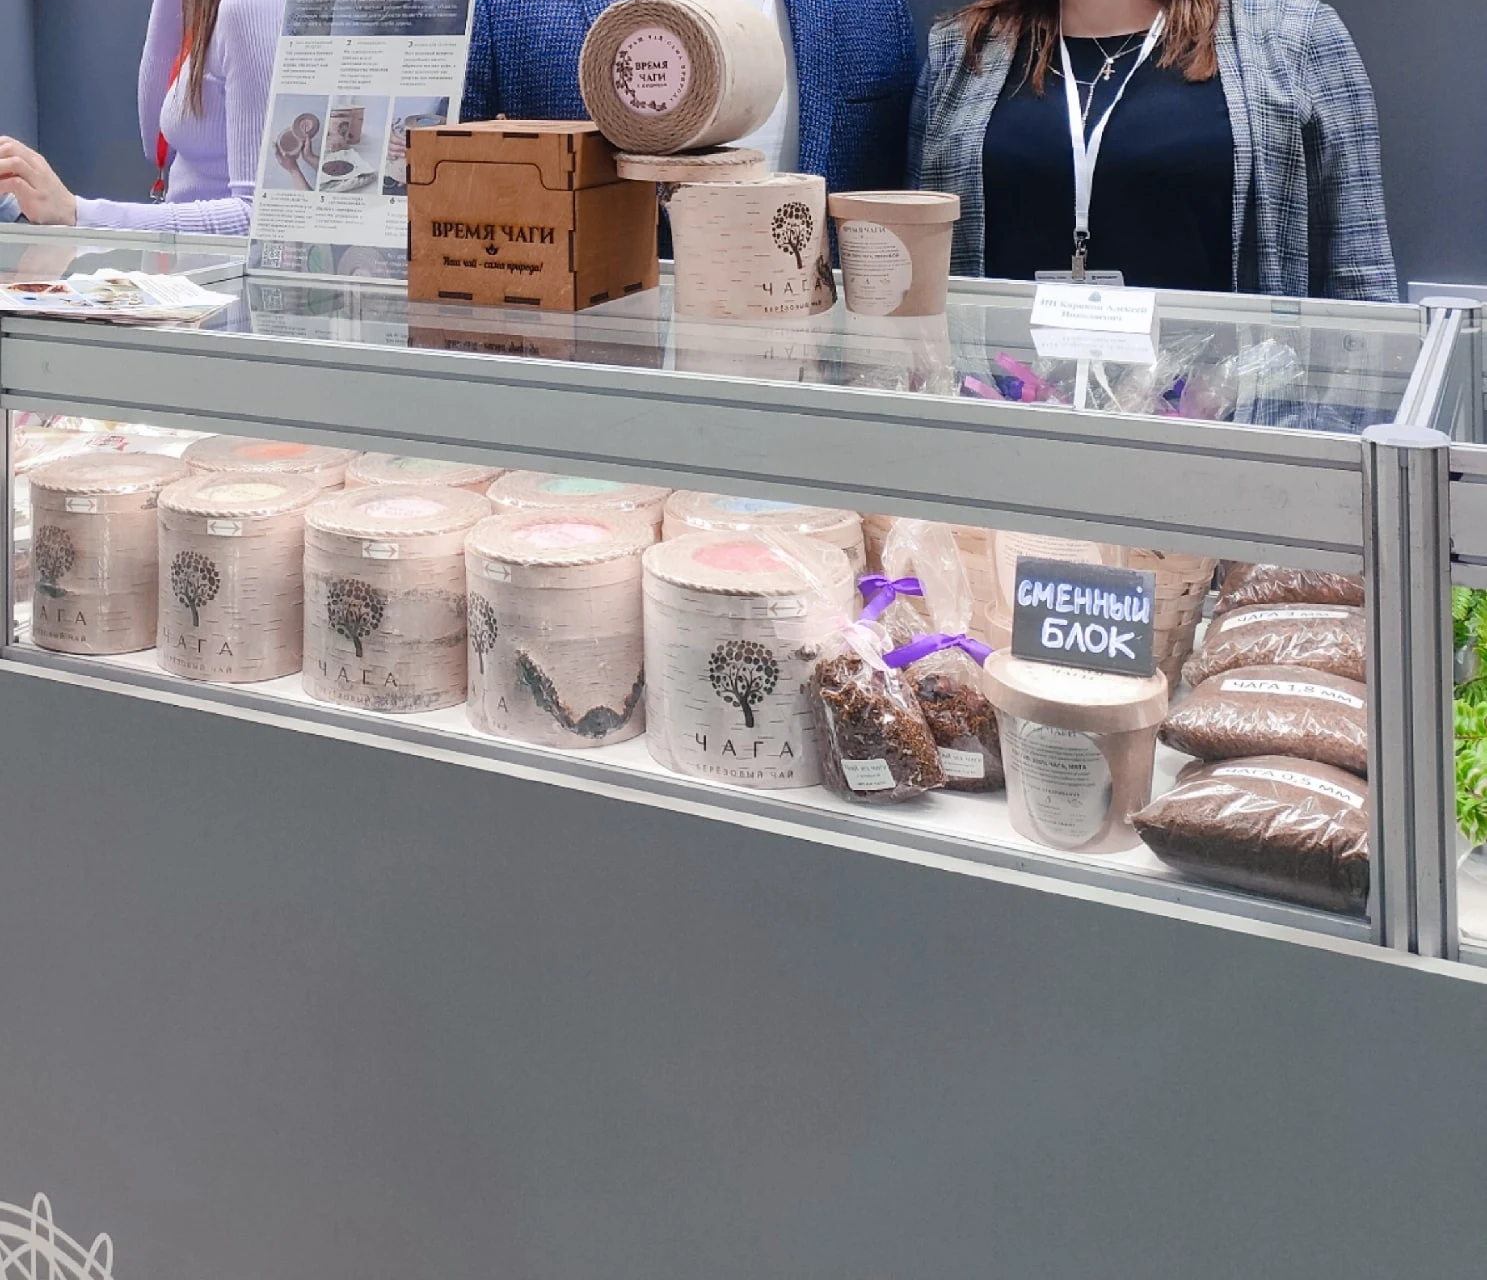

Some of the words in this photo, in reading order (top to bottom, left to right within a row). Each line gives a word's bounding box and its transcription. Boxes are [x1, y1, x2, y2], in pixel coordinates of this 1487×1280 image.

[635, 60, 668, 70] ВРЕМЯ
[639, 72, 666, 82] ЧАГИ
[432, 220, 496, 241] ВРЕМЯ
[500, 224, 555, 244] ЧАГИ
[443, 256, 461, 266] Наш
[463, 258, 477, 268] чай
[484, 261, 505, 269] сама
[506, 261, 544, 275] природа!
[762, 277, 822, 296] ЧАГА
[1017, 579, 1150, 624] СМЕННЫЙ
[1237, 611, 1279, 622] ЧАГА
[163, 625, 233, 656] ЧАГА
[1041, 617, 1136, 660] БЛОК
[318, 660, 398, 687] ЧАГА
[1233, 680, 1280, 690] ЧАГА
[695, 732, 794, 758] ЧАГА
[696, 763, 764, 778] БЕРЁЗОВЫЙ
[770, 770, 794, 778] ЧАЙ
[1225, 767, 1275, 777] ЧАГА
